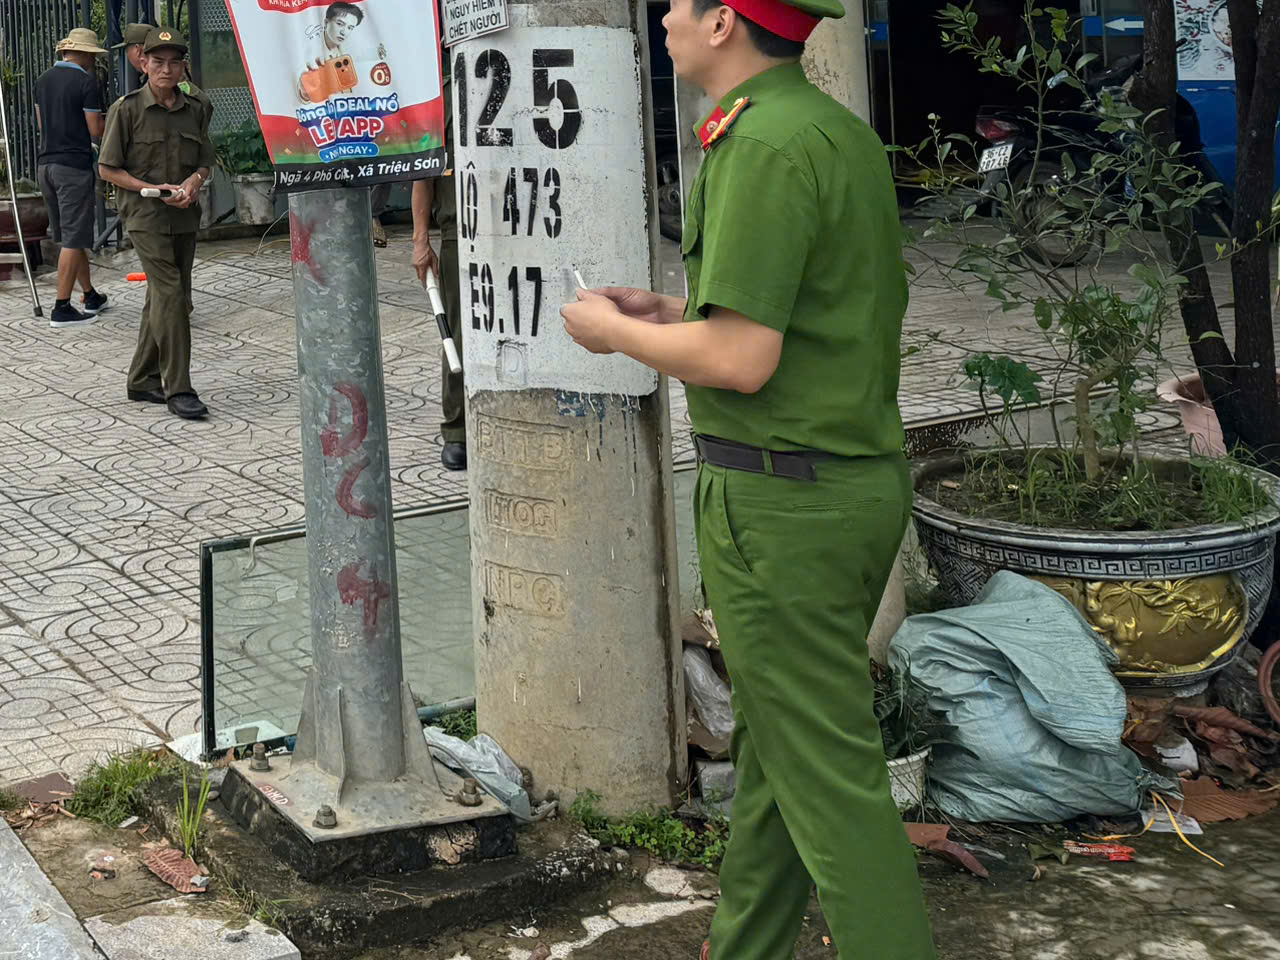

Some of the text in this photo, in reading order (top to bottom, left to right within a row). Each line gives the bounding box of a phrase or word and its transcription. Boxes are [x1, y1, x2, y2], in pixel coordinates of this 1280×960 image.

[449, 2, 471, 21] NGUY
[336, 98, 372, 113] DEAL
[375, 93, 399, 113] NỔ
[454, 48, 582, 150] 125
[309, 117, 384, 147] LÊ APP
[339, 145, 368, 155] NGAY
[280, 171, 300, 186] Ngã
[303, 171, 311, 183] 4
[312, 167, 333, 183] Phố
[357, 163, 374, 178] Xã
[377, 160, 411, 177] Triệu
[413, 156, 440, 171] Sơn
[502, 167, 562, 239] 473
[469, 262, 542, 337] E9.17
